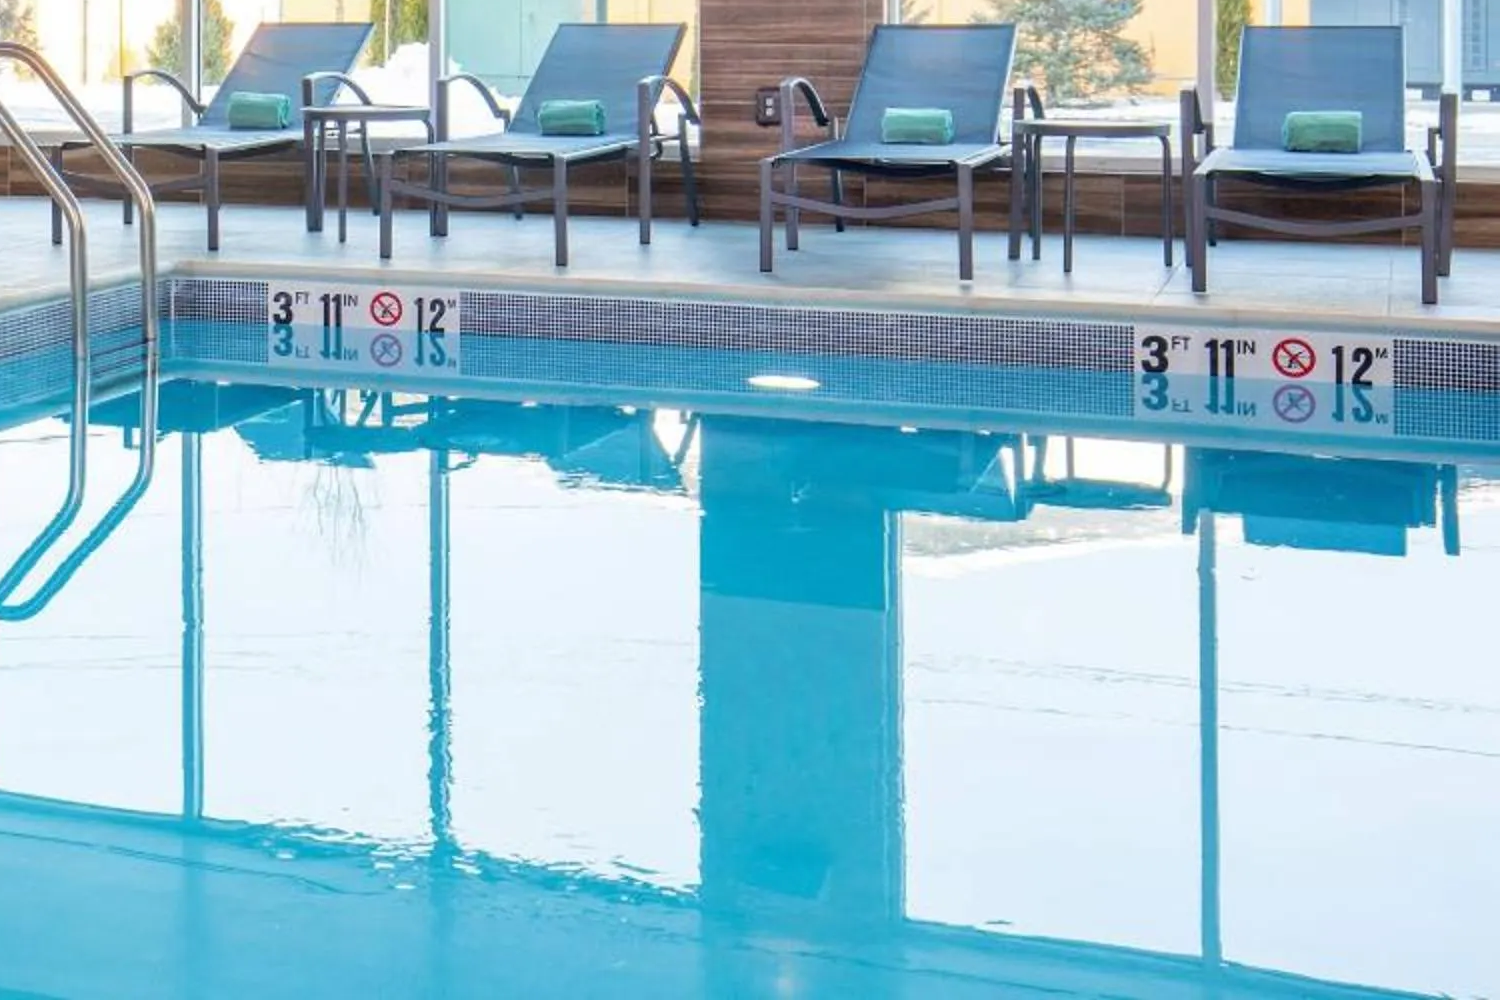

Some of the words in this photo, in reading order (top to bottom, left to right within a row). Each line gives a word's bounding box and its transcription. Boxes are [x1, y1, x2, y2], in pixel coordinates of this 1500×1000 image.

[273, 291, 293, 325] 3
[295, 291, 310, 305] FT
[320, 293, 343, 328] 11
[344, 294, 359, 307] IN
[1141, 335, 1169, 373] 3
[1171, 336, 1192, 351] FT
[1204, 339, 1235, 378] 11
[1237, 340, 1256, 355] IN
